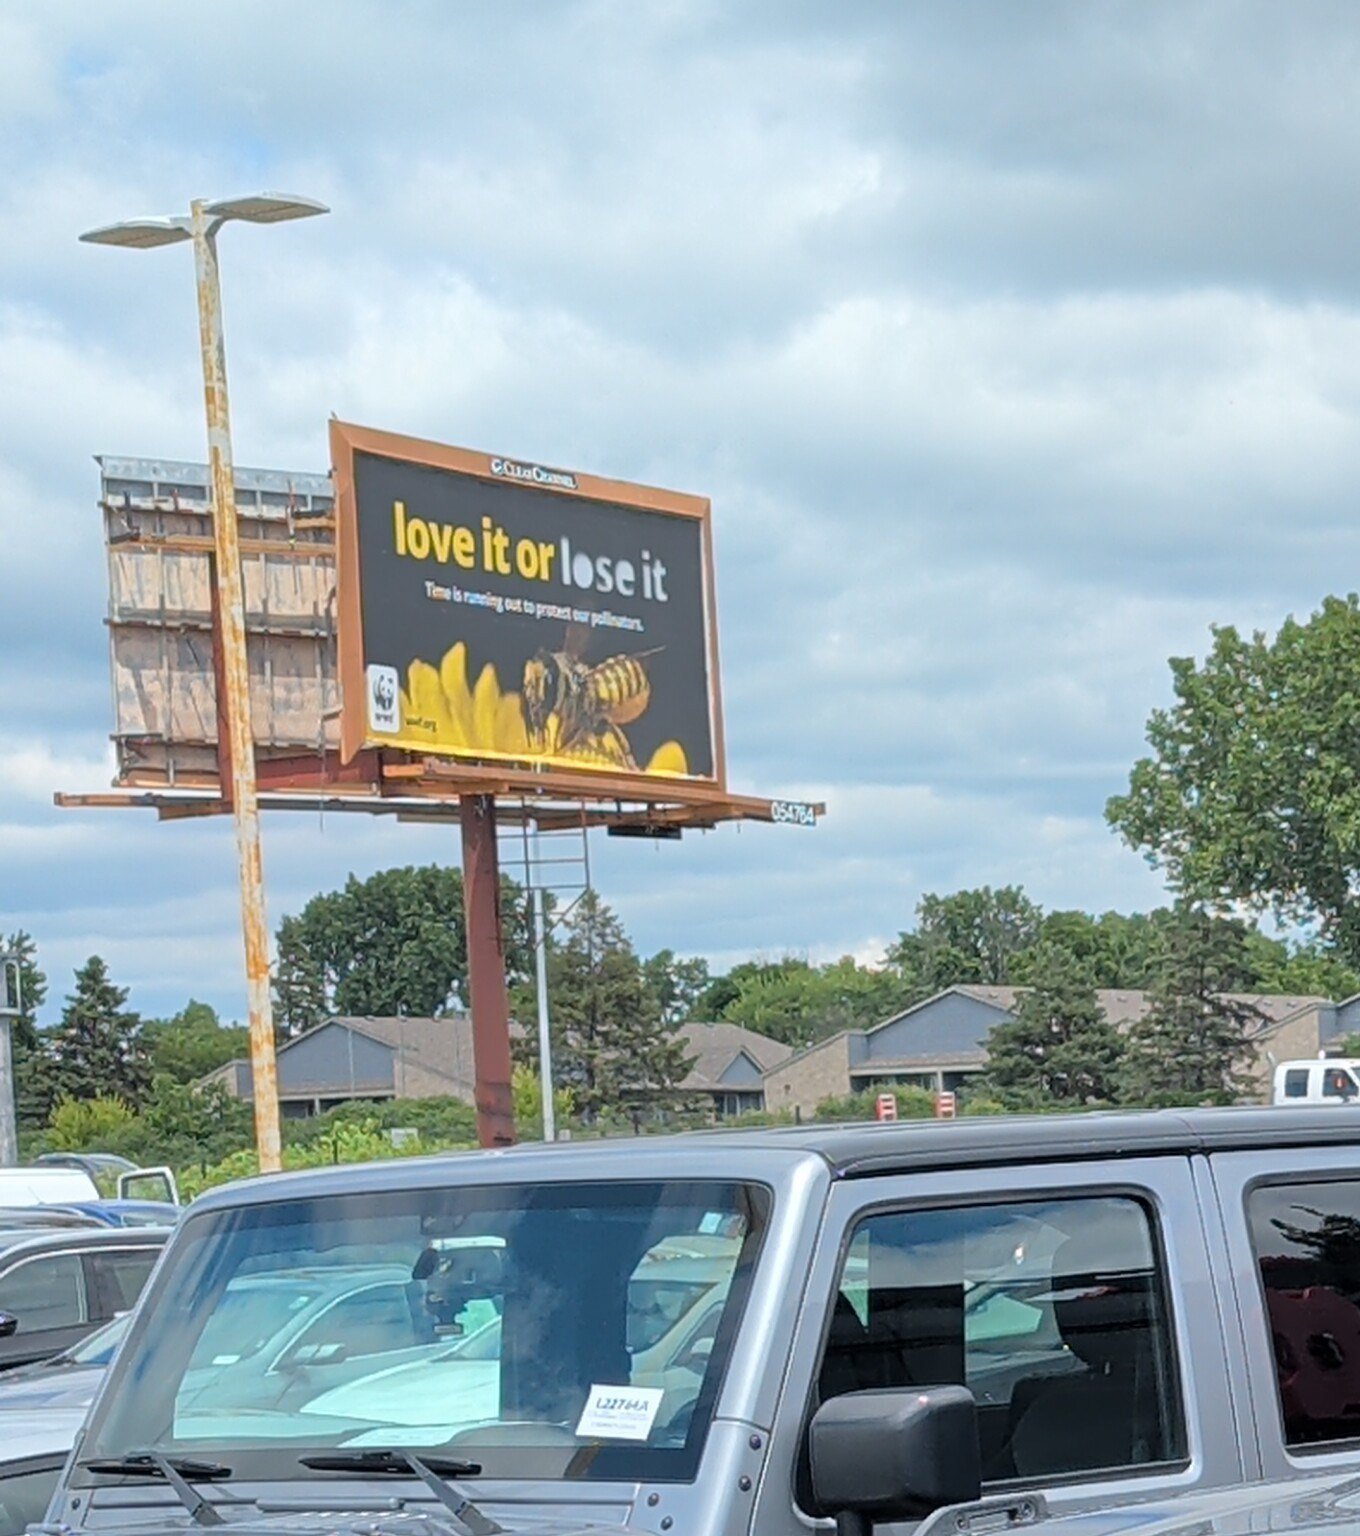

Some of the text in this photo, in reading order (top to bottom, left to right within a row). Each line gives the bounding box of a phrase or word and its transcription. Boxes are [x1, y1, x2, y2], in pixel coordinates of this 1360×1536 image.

[394, 501, 669, 602] love it or lose it
[424, 581, 451, 601] Time
[452, 585, 463, 603] is
[464, 590, 504, 613] running
[504, 598, 523, 614] out
[523, 600, 536, 615] to
[536, 603, 573, 621] protect
[573, 608, 591, 623] our
